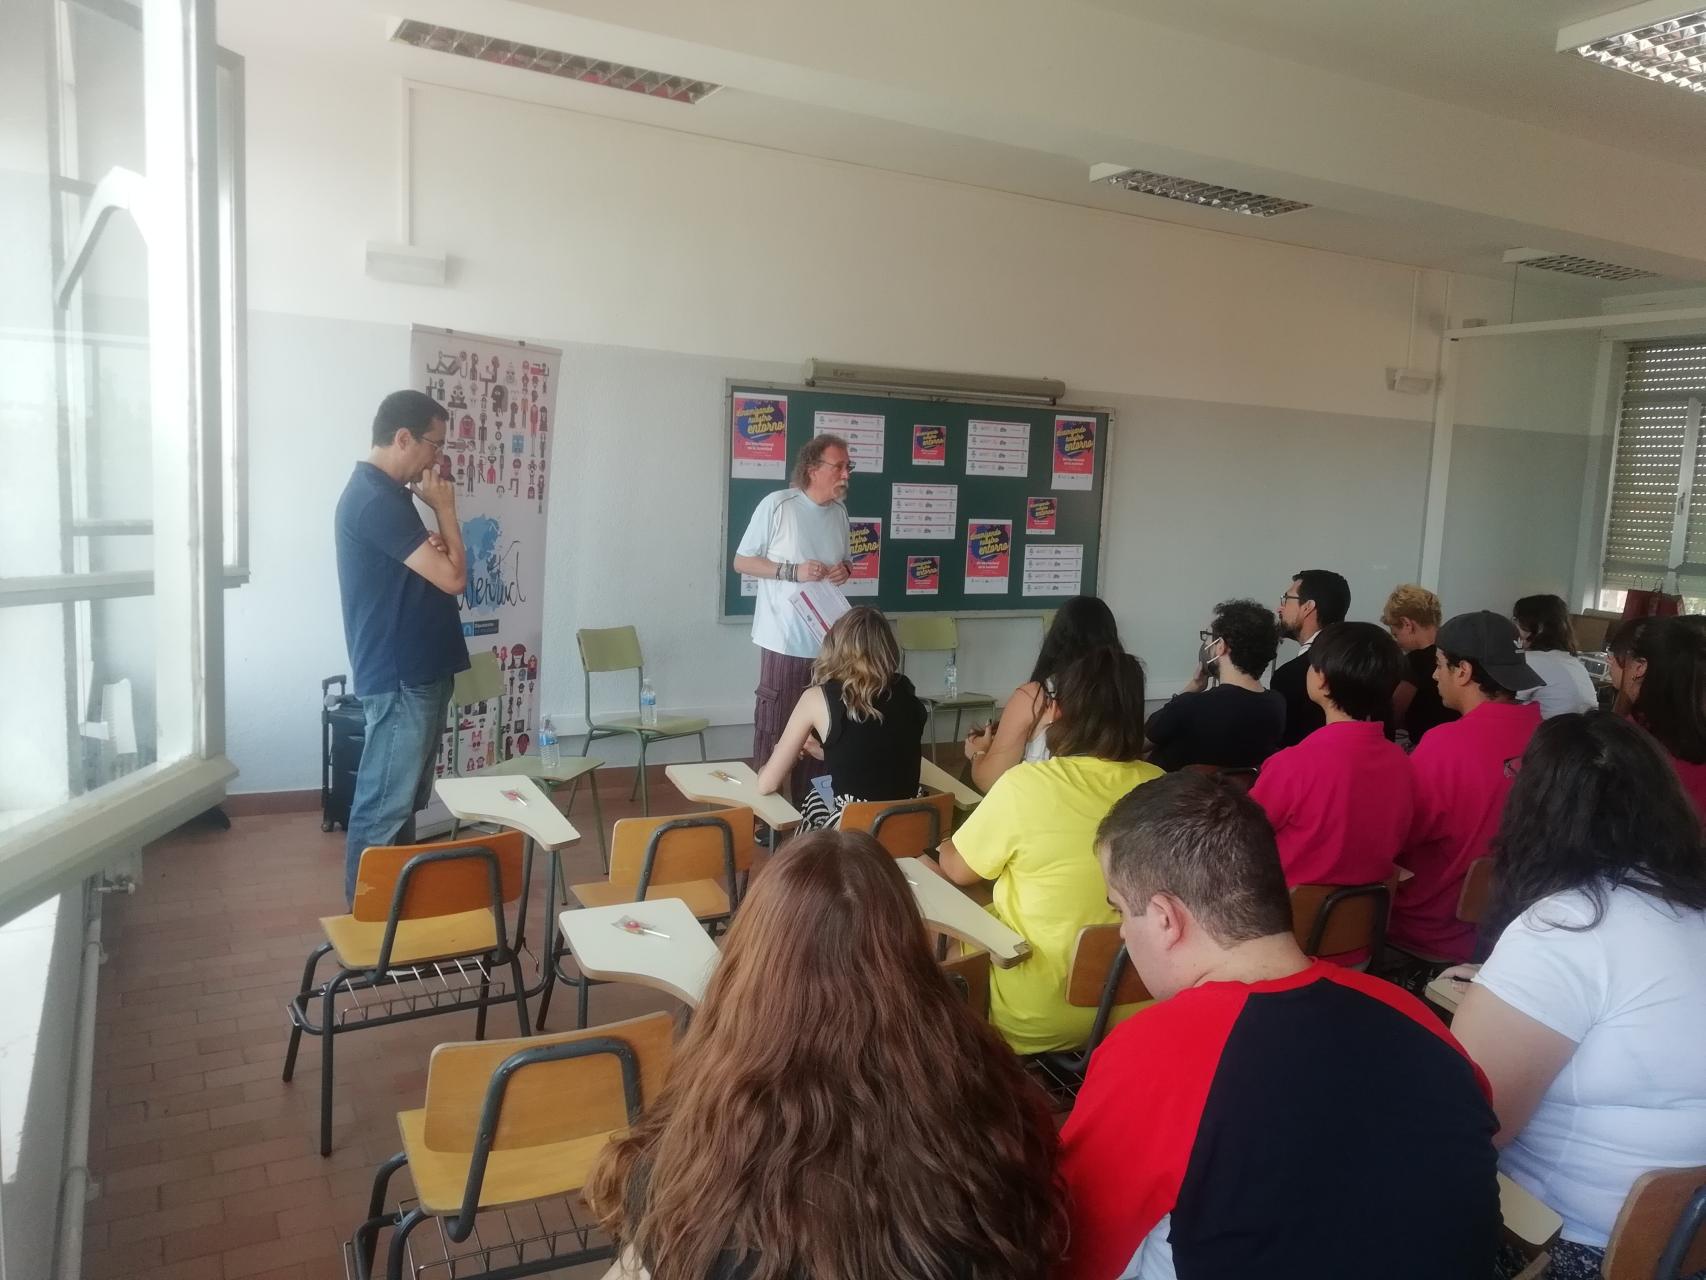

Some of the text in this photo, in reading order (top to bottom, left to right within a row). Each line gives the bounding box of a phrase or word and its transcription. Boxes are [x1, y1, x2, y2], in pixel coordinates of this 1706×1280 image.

[747, 421, 785, 434] entorno
[1064, 440, 1094, 452] entorno
[978, 543, 1009, 555] entorno
